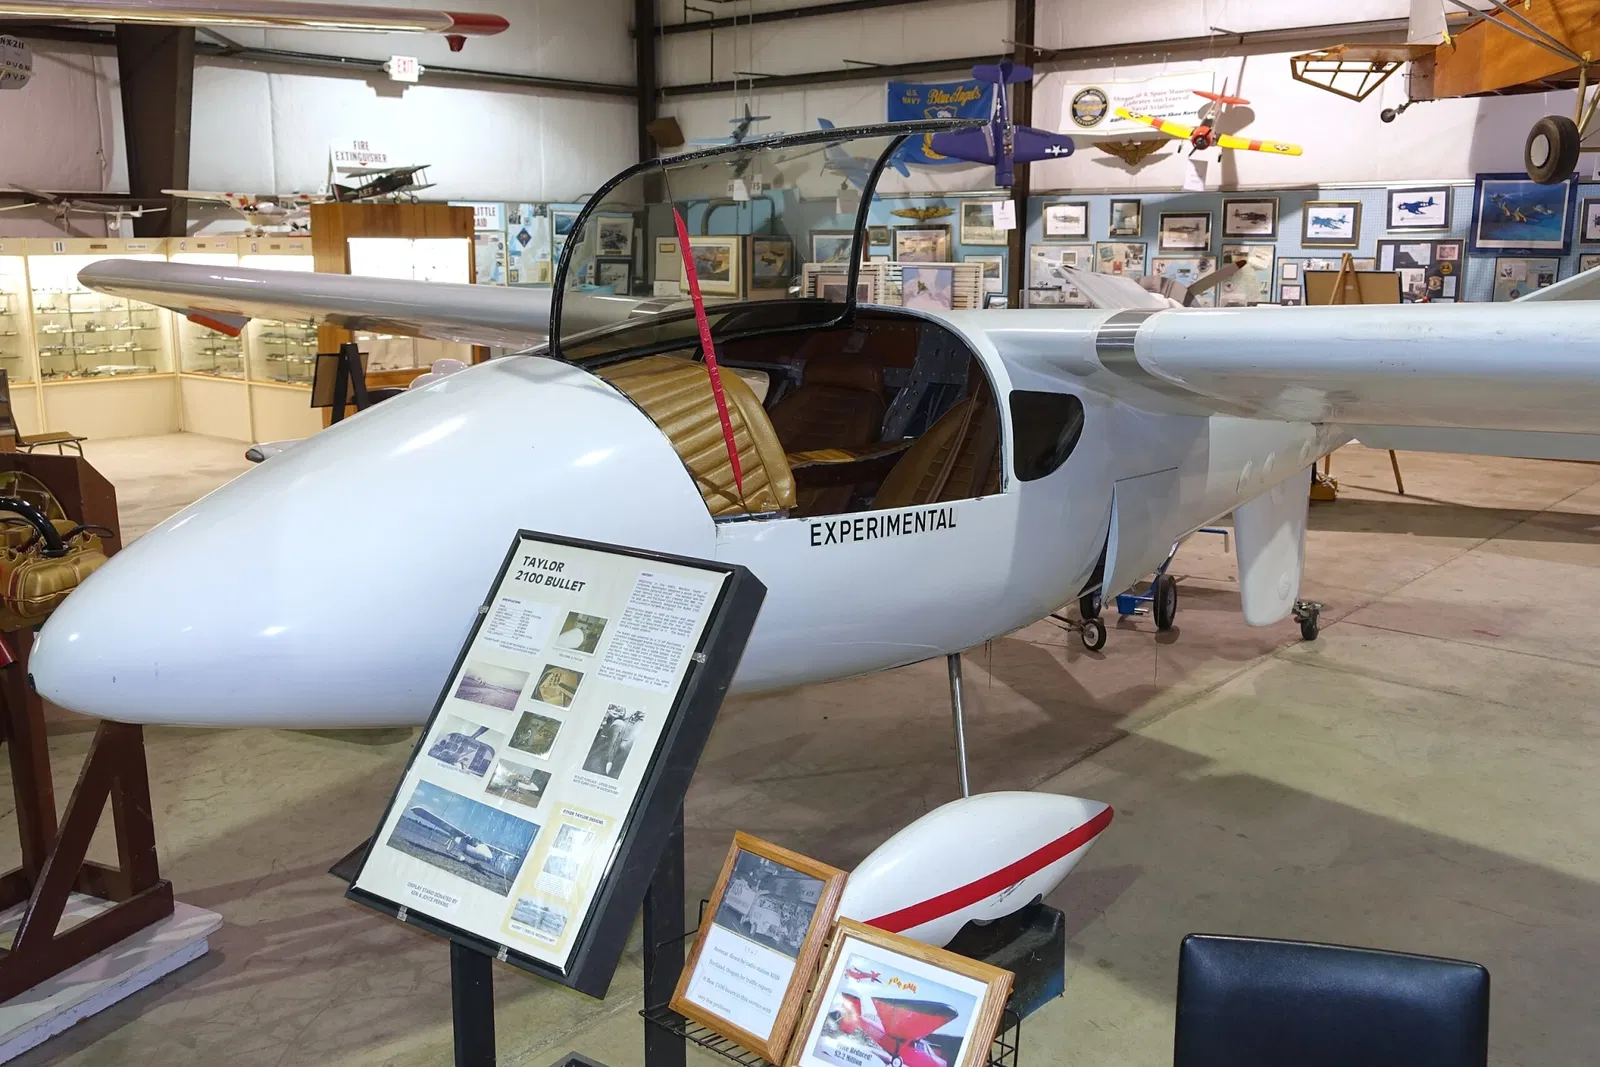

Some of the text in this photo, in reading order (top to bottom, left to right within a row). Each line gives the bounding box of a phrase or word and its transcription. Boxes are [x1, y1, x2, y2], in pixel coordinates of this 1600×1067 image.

[398, 58, 414, 74] EXIT
[927, 88, 949, 104] Blue
[949, 85, 981, 106] Angels
[353, 140, 370, 151] FIRE
[335, 151, 388, 163] EXTINGUISHER
[810, 508, 956, 546] EXPERIMENTAL
[522, 556, 565, 572] TAYLOR
[515, 570, 586, 592] 2100 BULLET
[562, 808, 574, 816] OTHER
[575, 812, 589, 820] TAYLOR
[406, 882, 422, 890] DISPLAY
[422, 887, 434, 896] STAND
[434, 892, 452, 902] DONATED
[888, 976, 902, 988] FOR
